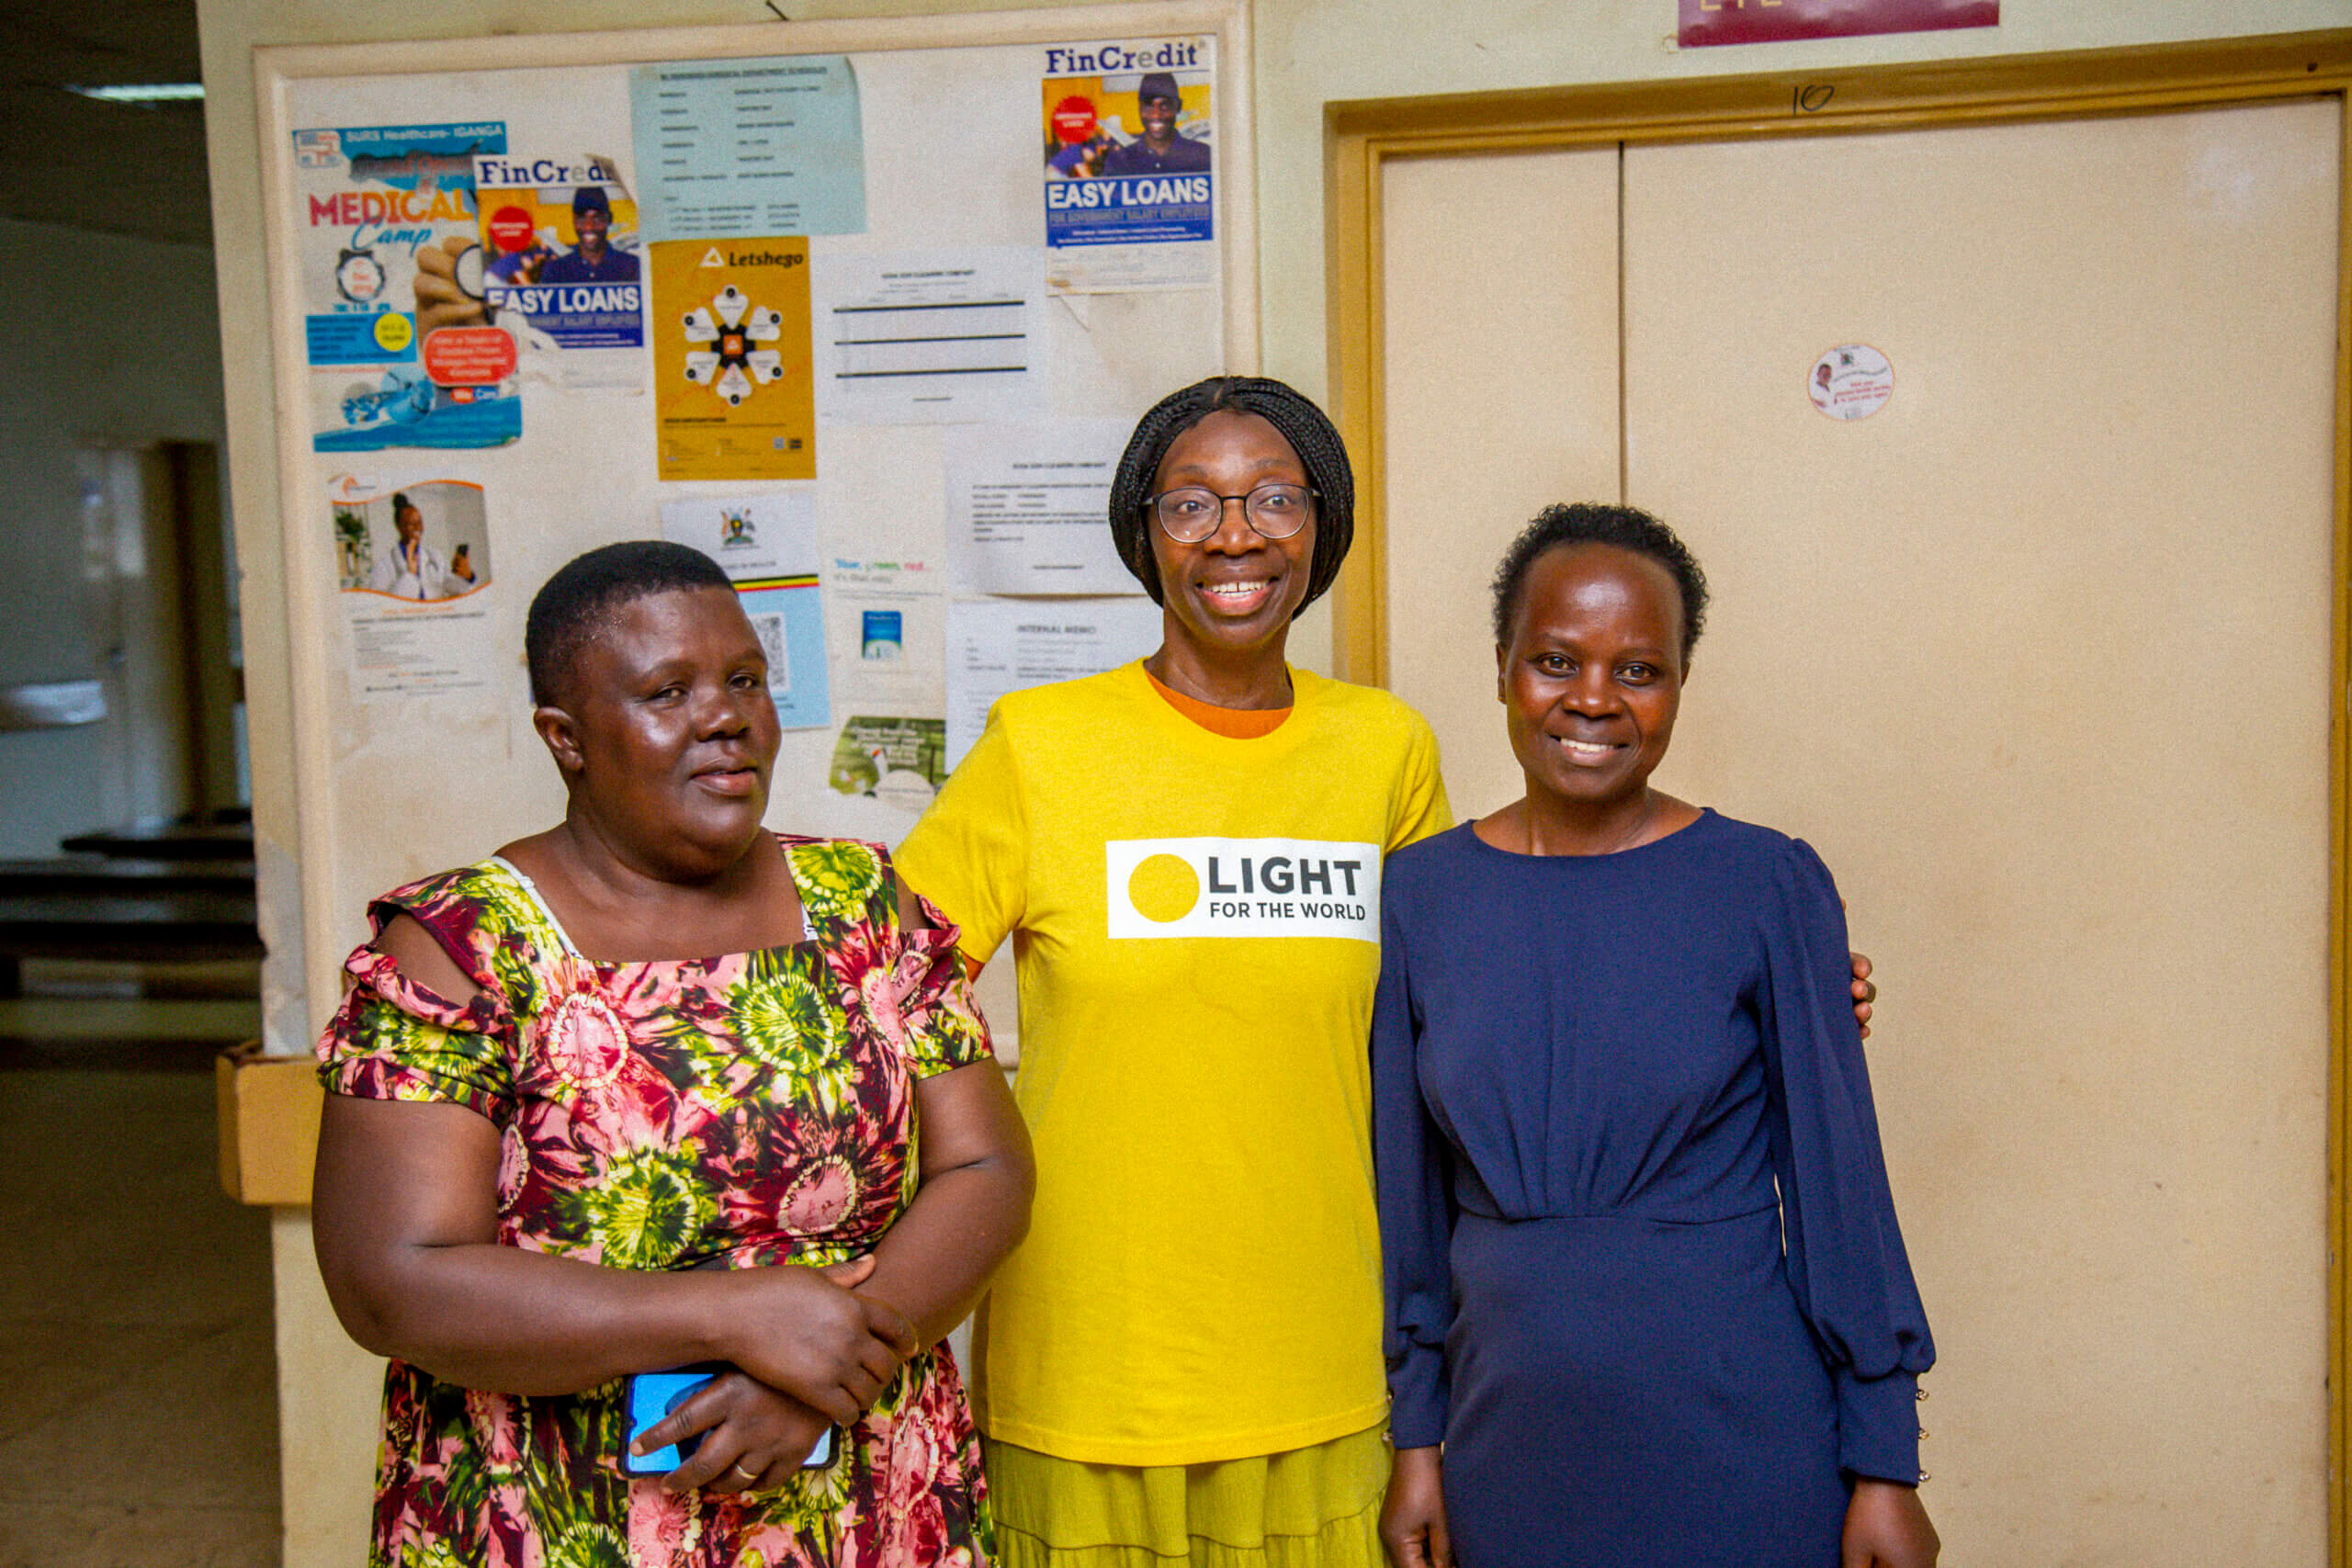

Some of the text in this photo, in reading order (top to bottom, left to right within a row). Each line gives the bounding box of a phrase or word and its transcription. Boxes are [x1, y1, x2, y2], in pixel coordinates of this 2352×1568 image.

[1045, 42, 1198, 73] FinCredit
[1792, 85, 1836, 116] 10
[478, 160, 614, 184] FinCred
[308, 187, 476, 227] MEDICAL
[1047, 176, 1210, 209] EASY LOANS
[351, 219, 433, 257] Camp
[729, 251, 805, 268] Letshego
[487, 286, 640, 313] EASY LOANS
[1207, 855, 1363, 897] LIGHT
[1209, 902, 1366, 921] FOR THE WORLD
